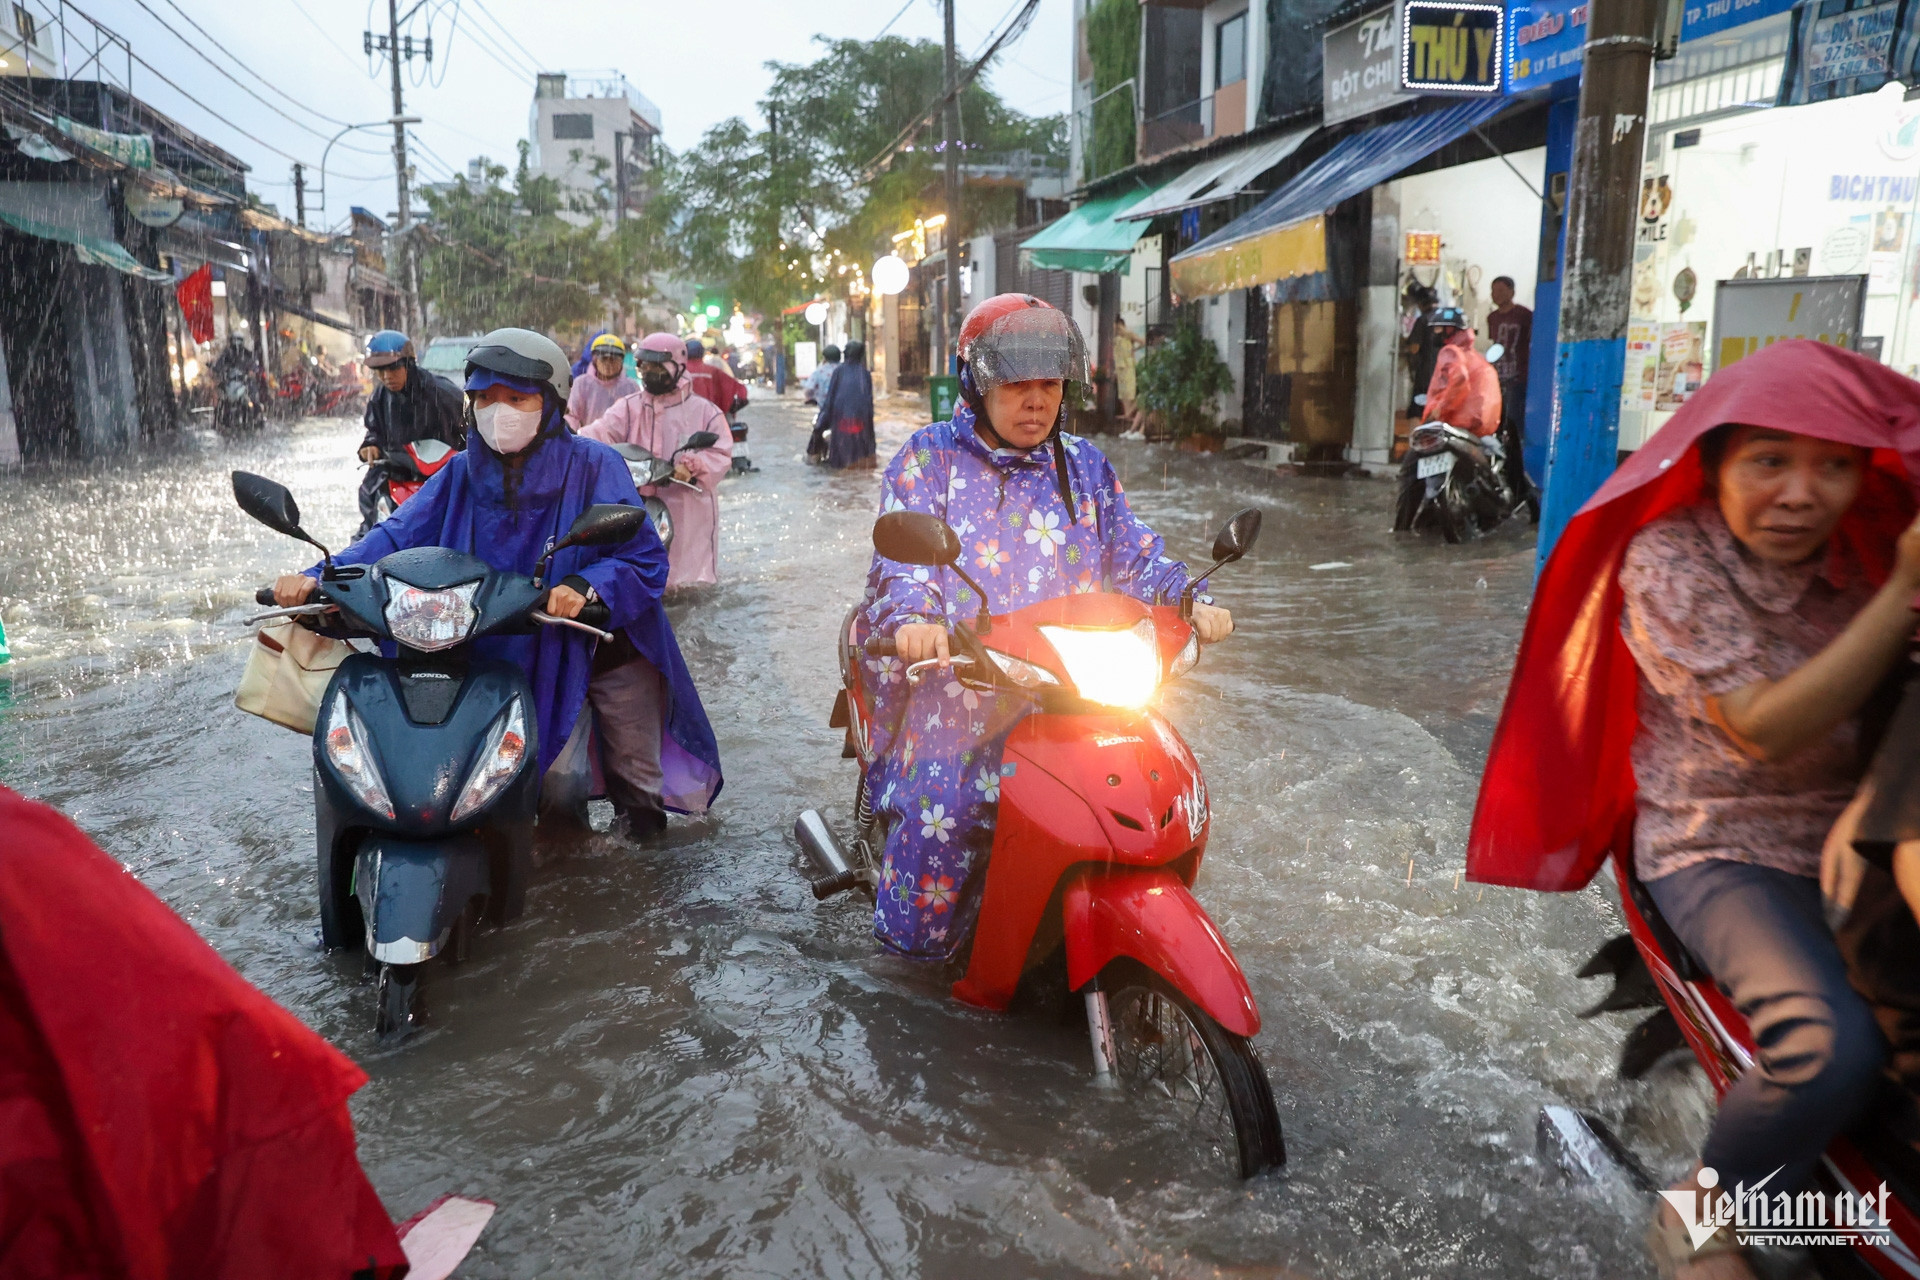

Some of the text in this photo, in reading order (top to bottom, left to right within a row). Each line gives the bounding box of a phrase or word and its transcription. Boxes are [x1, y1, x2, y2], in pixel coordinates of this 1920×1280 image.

[1411, 12, 1495, 82] THÚ Y
[1095, 736, 1144, 747] HONDA
